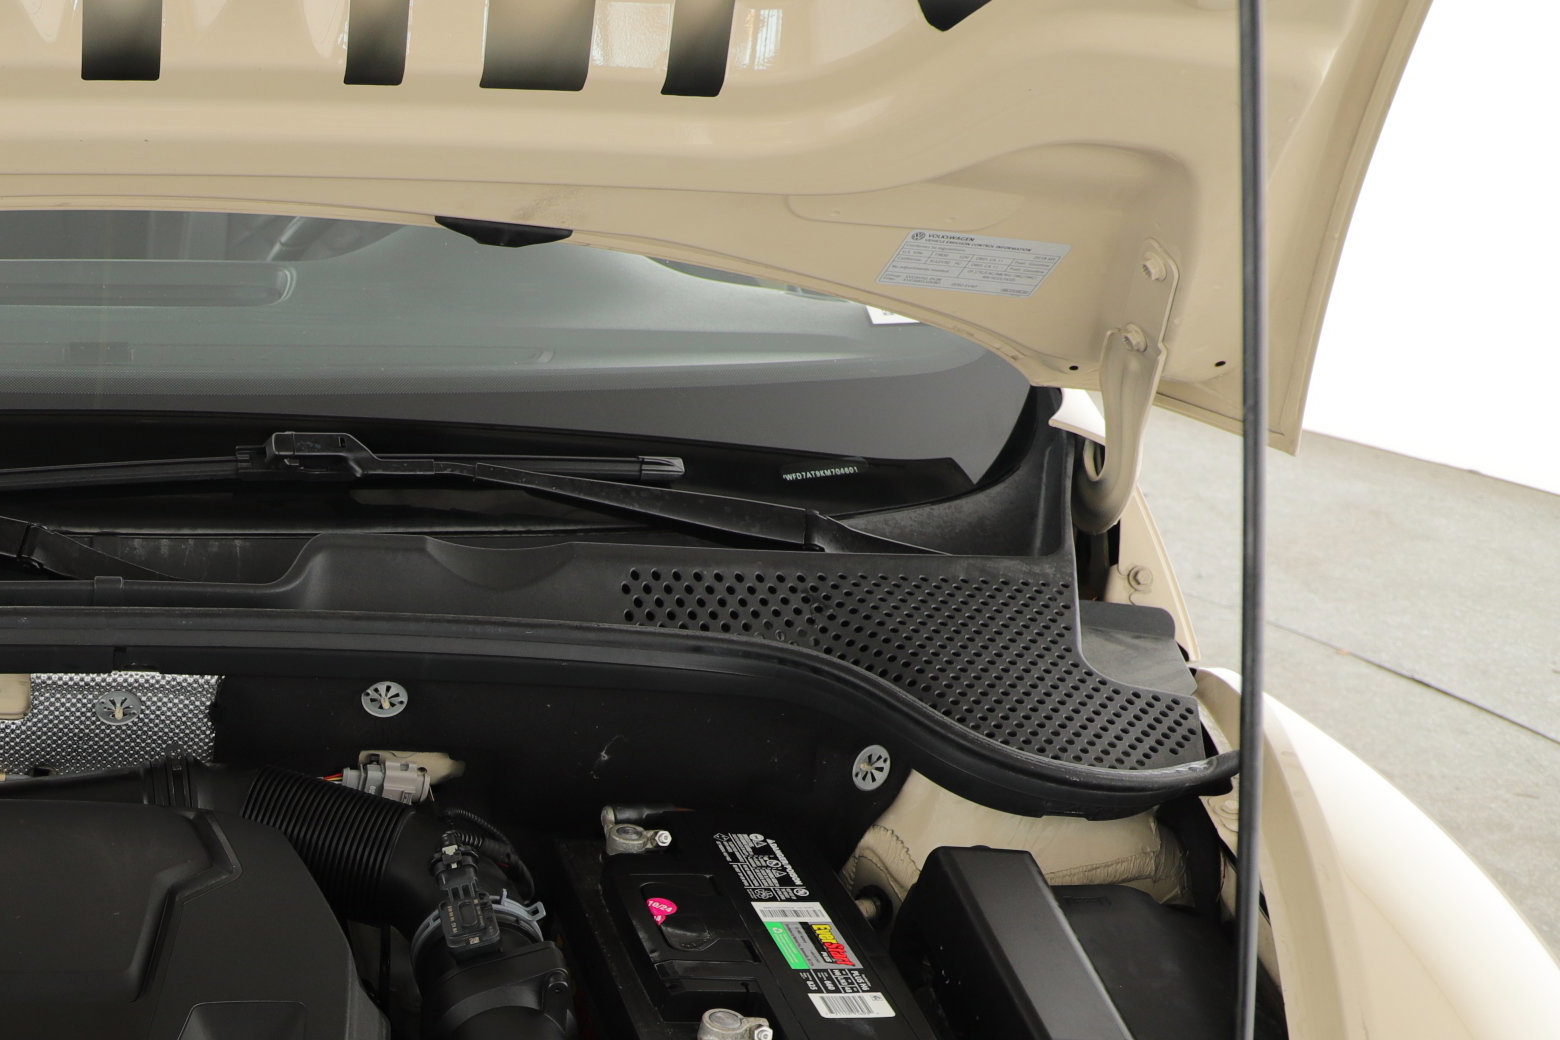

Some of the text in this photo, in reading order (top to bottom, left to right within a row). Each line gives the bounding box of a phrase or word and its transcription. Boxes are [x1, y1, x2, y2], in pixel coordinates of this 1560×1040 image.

[927, 233, 975, 242] VOLKSWAGEN
[647, 900, 673, 913] 10/24
[811, 924, 855, 966] EverStart
